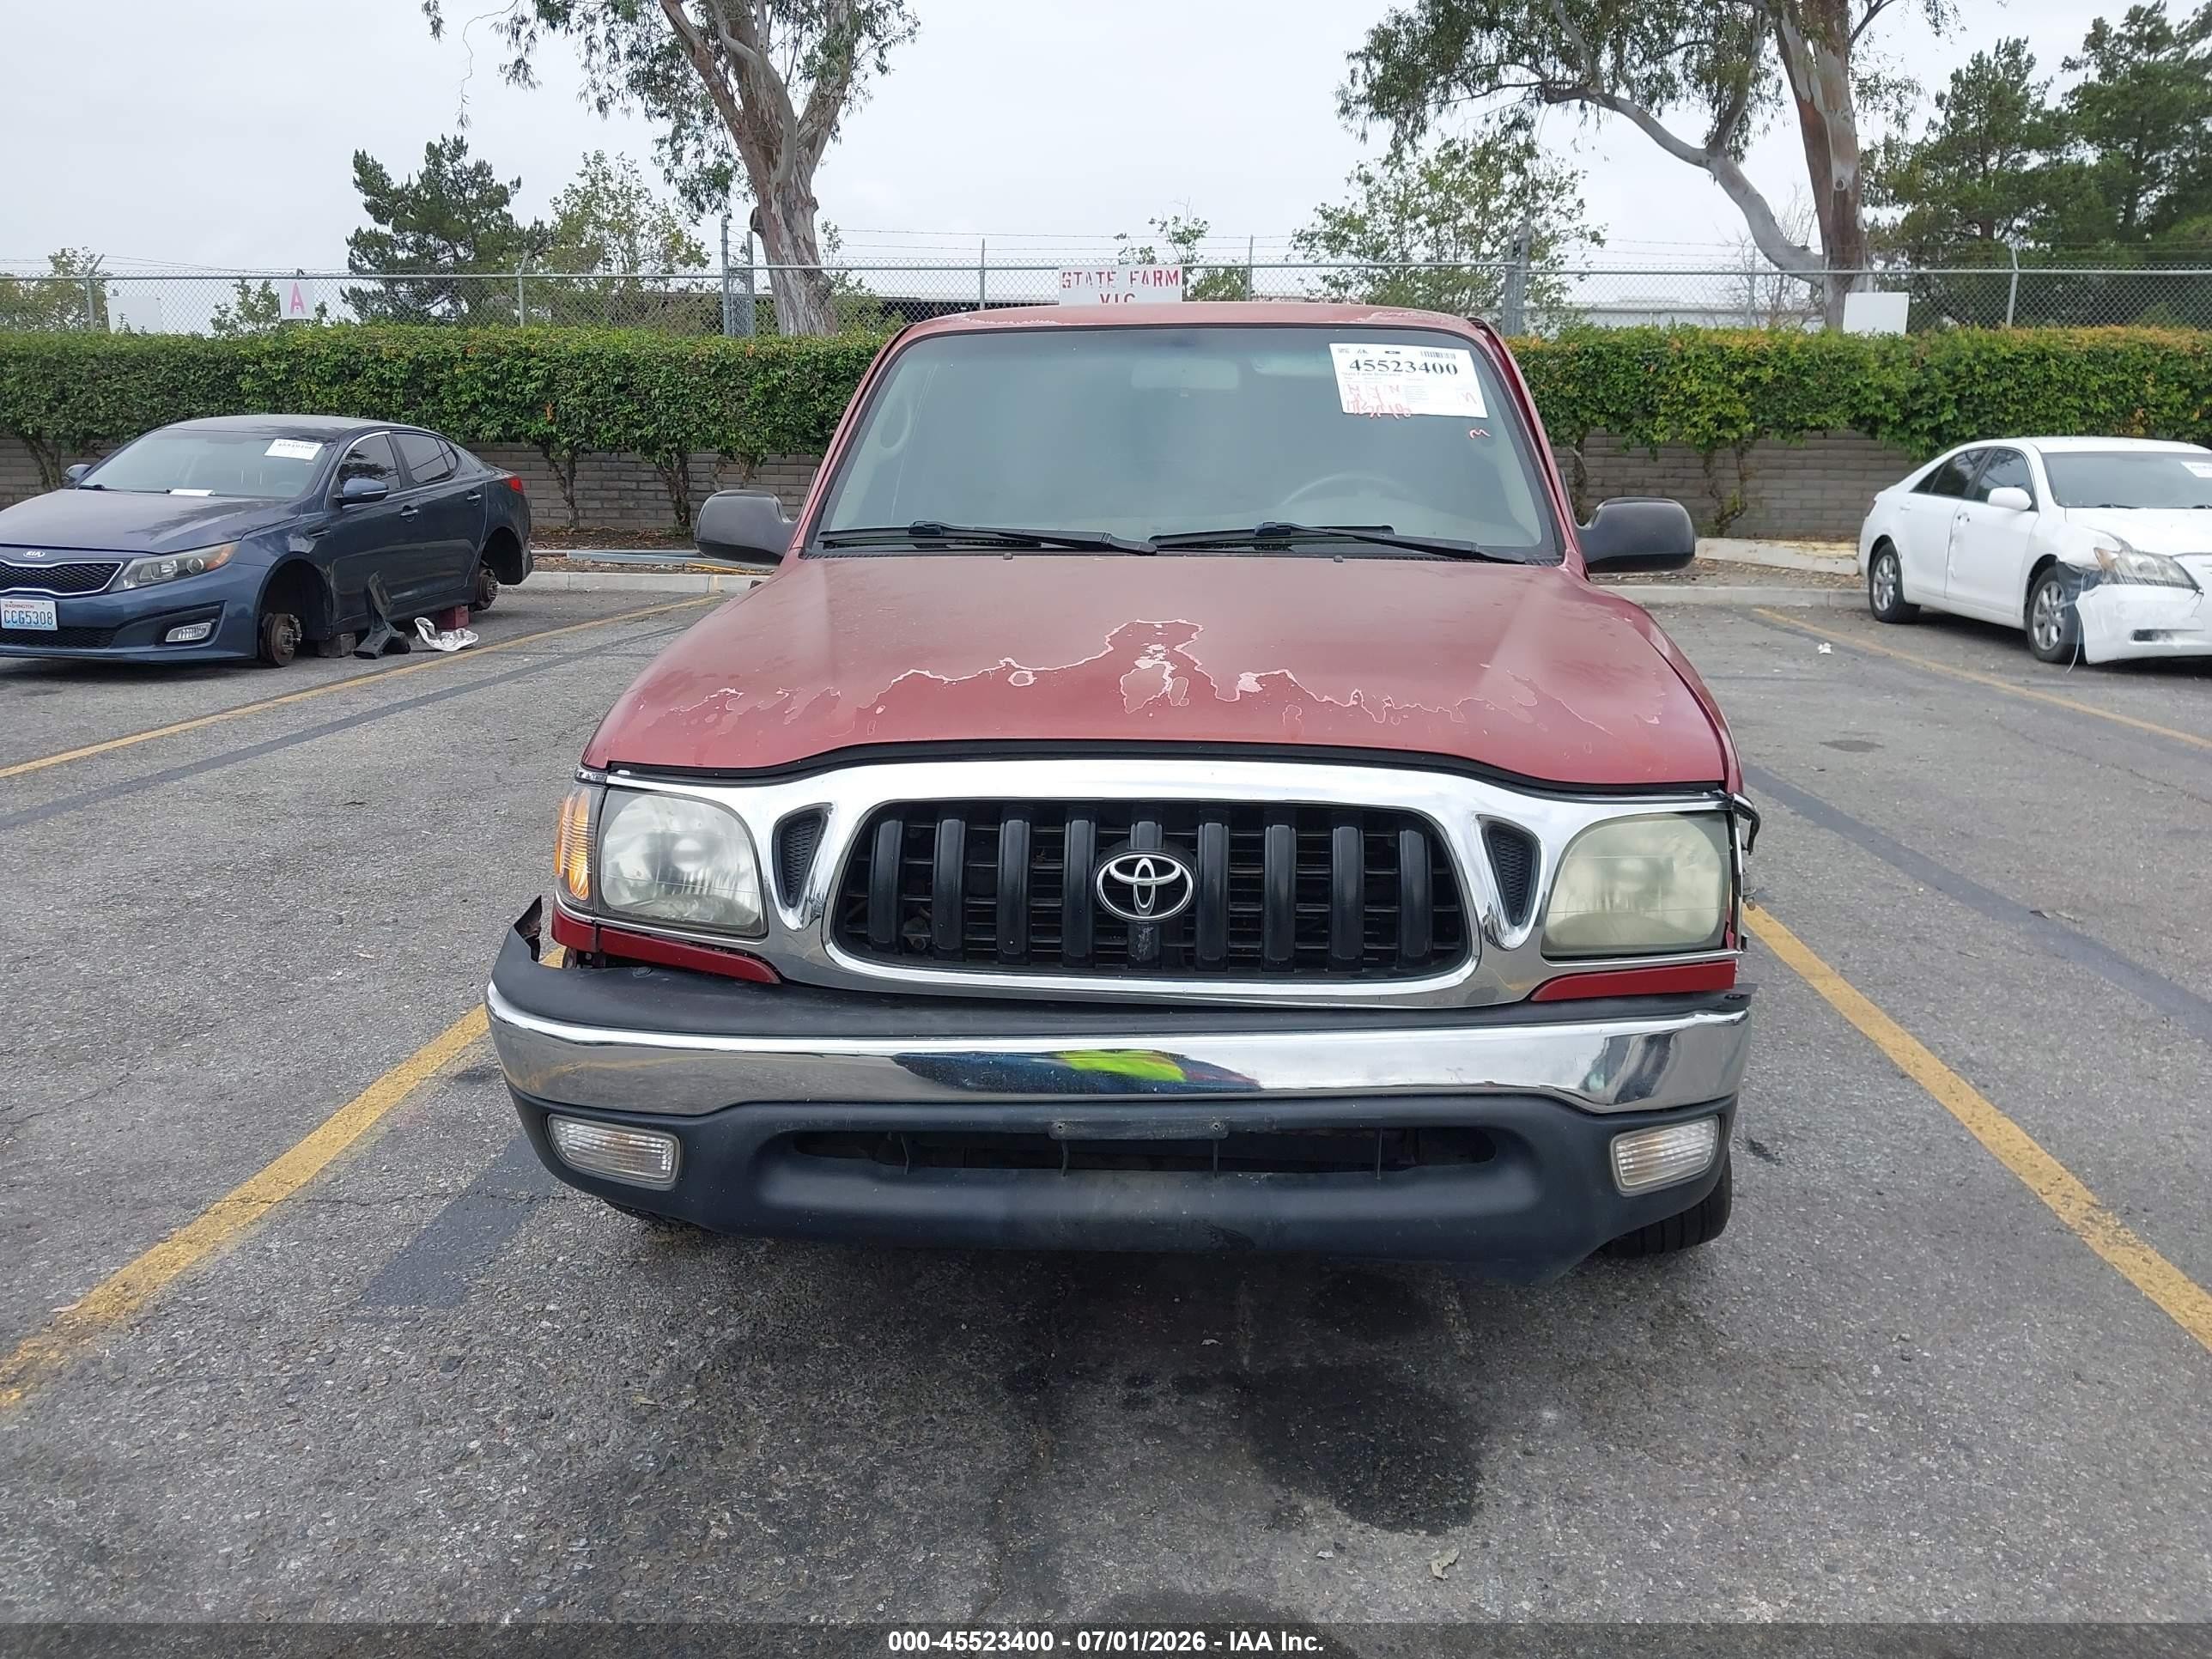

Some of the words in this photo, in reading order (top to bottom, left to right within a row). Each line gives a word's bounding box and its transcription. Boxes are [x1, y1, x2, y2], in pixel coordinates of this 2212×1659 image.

[1061, 271, 1116, 289] STATE
[1129, 270, 1179, 288] FARM
[289, 282, 307, 314] A
[1349, 359, 1458, 375] 45523400
[3, 610, 53, 626] CCG5308
